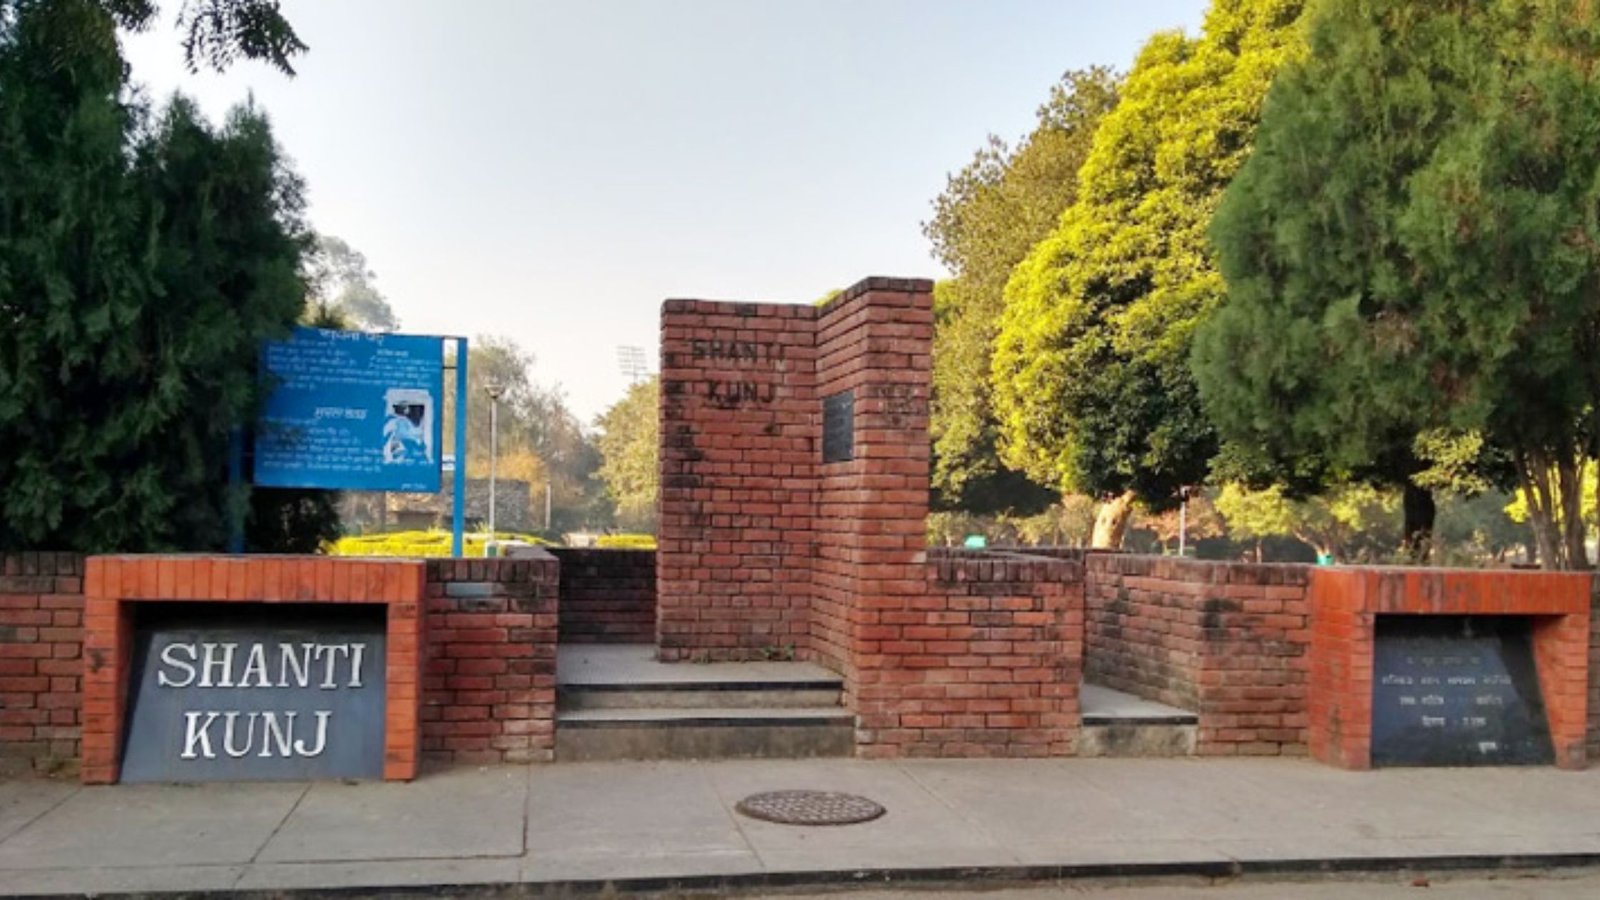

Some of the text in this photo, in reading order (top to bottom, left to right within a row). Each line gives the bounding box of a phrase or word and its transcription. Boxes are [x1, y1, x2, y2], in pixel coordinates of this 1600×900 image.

[708, 380, 775, 404] KUNJ
[157, 642, 366, 689] SHANTI
[180, 710, 333, 758] KUNJ
